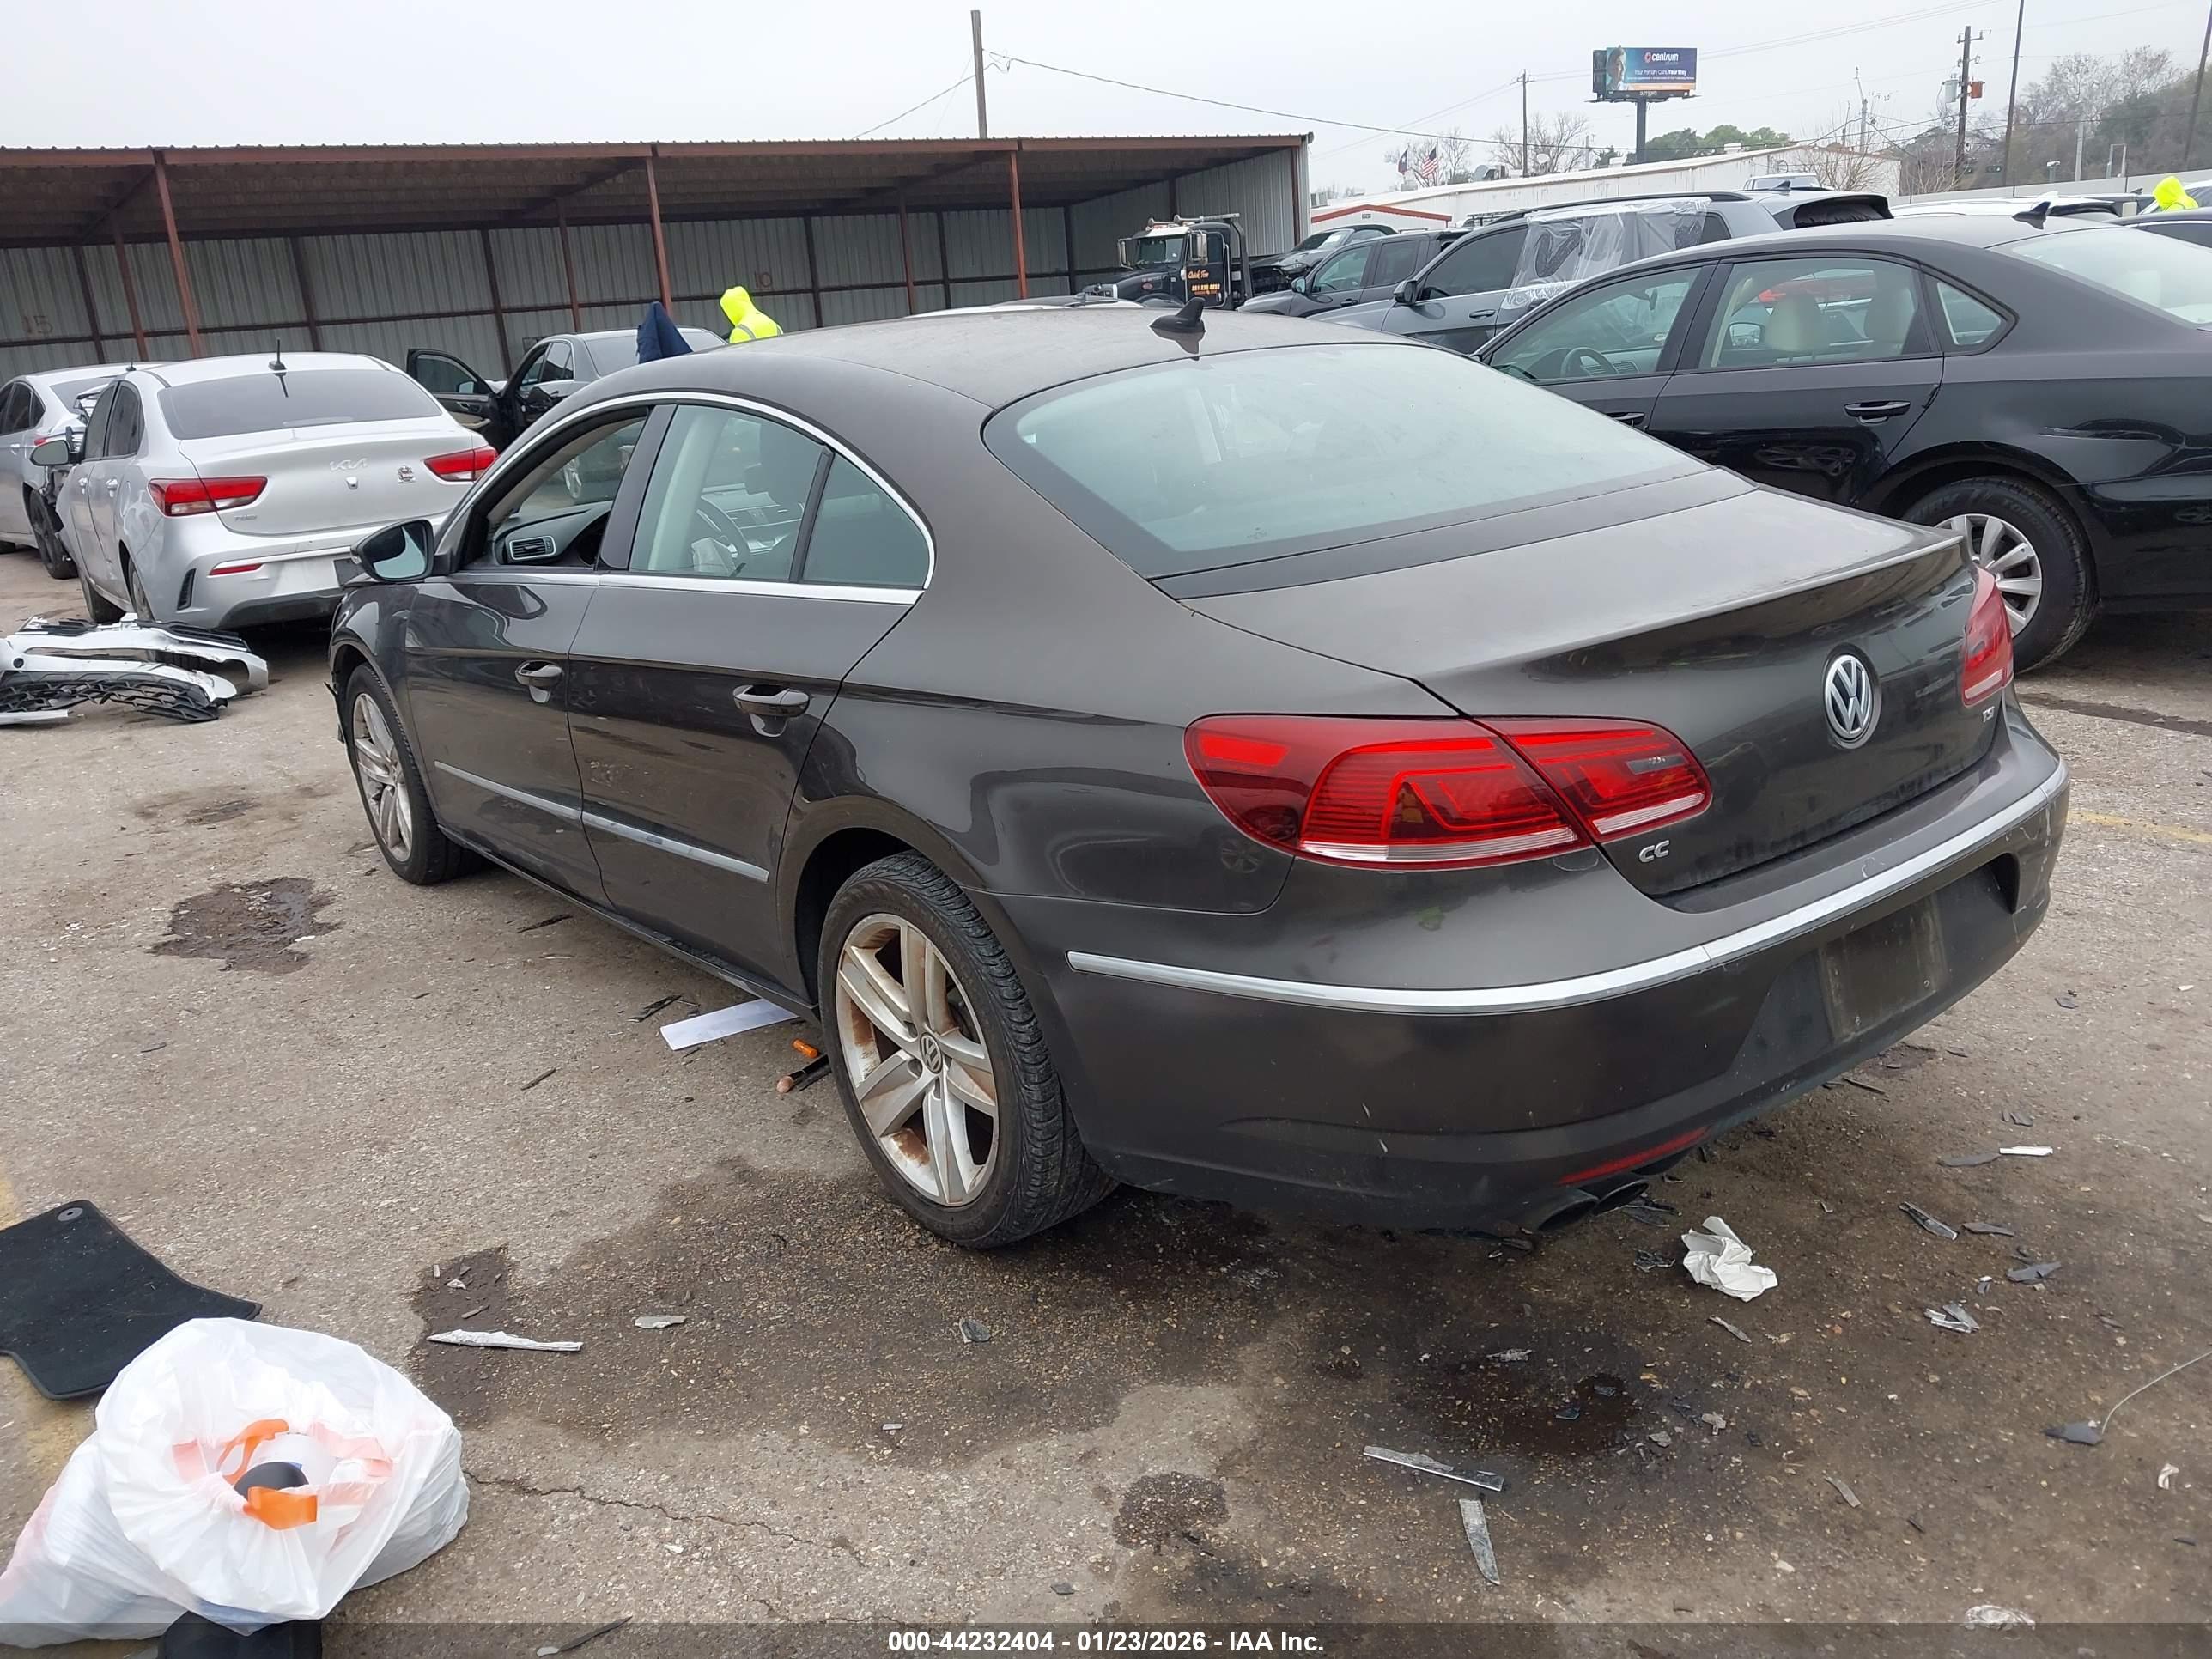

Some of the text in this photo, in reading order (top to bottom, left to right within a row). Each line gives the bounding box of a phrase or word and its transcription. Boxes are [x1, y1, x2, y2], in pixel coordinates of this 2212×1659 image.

[1651, 52, 1679, 62] centrum
[1825, 655, 1874, 739] VW
[1638, 839, 1670, 863] CC
